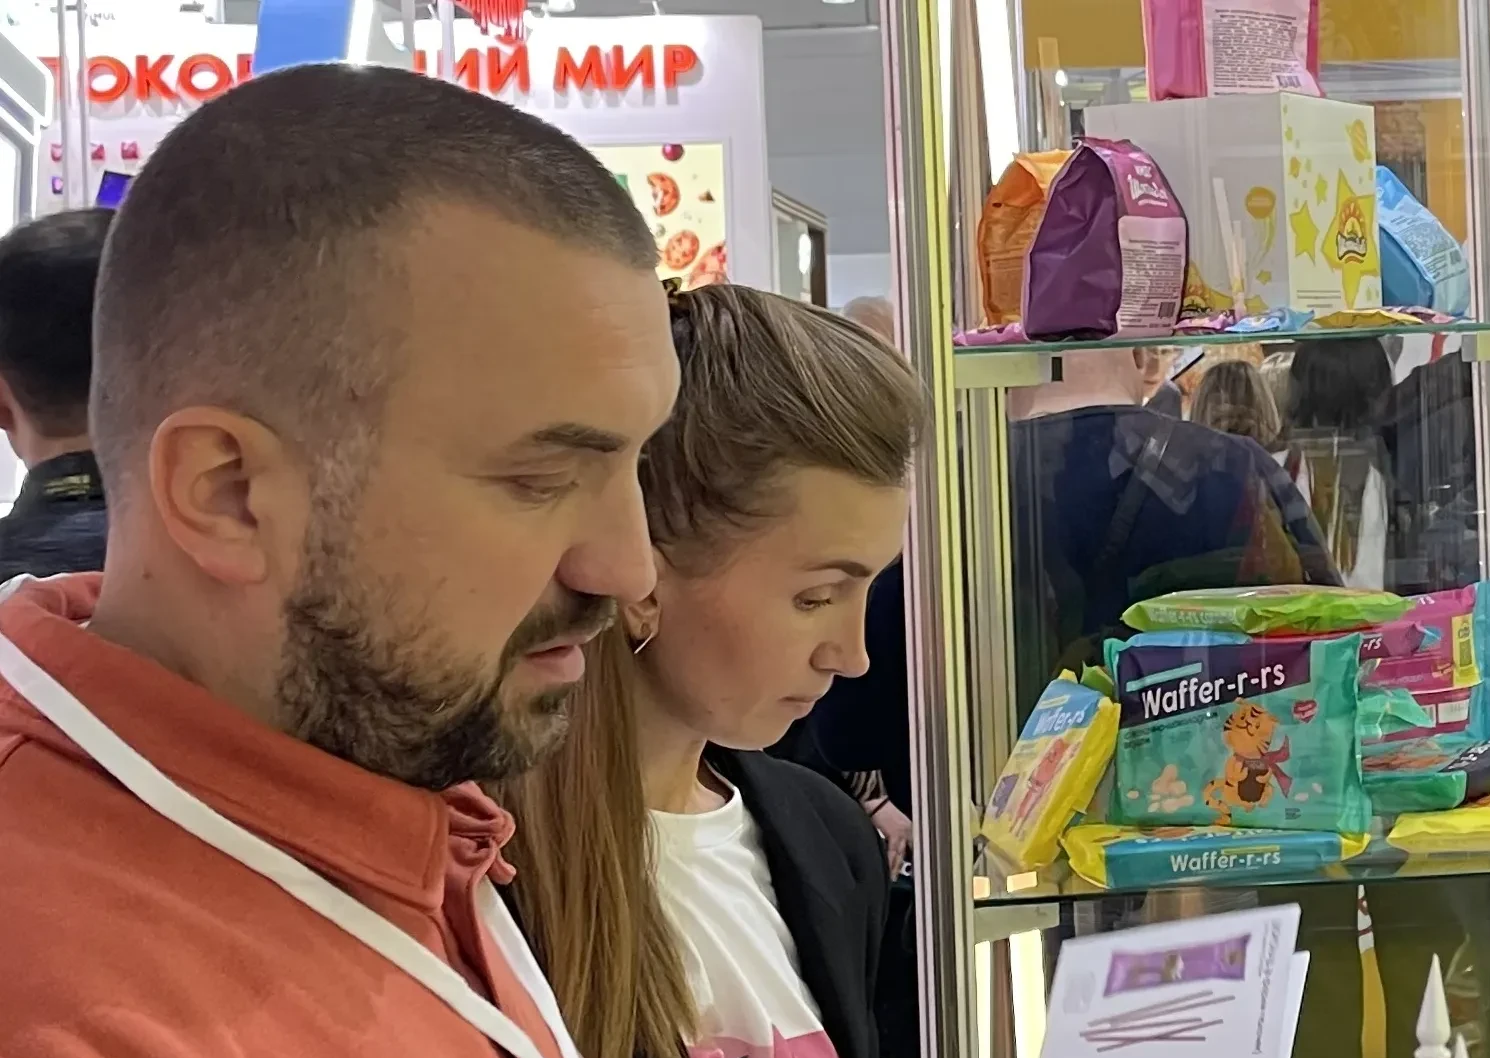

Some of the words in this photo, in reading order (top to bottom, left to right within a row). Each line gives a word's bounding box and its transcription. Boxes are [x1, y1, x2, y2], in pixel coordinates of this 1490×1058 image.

[553, 44, 698, 91] МИР
[1142, 663, 1286, 718] Waffer-r-rs
[1171, 851, 1281, 873] Waffer-r-rs
